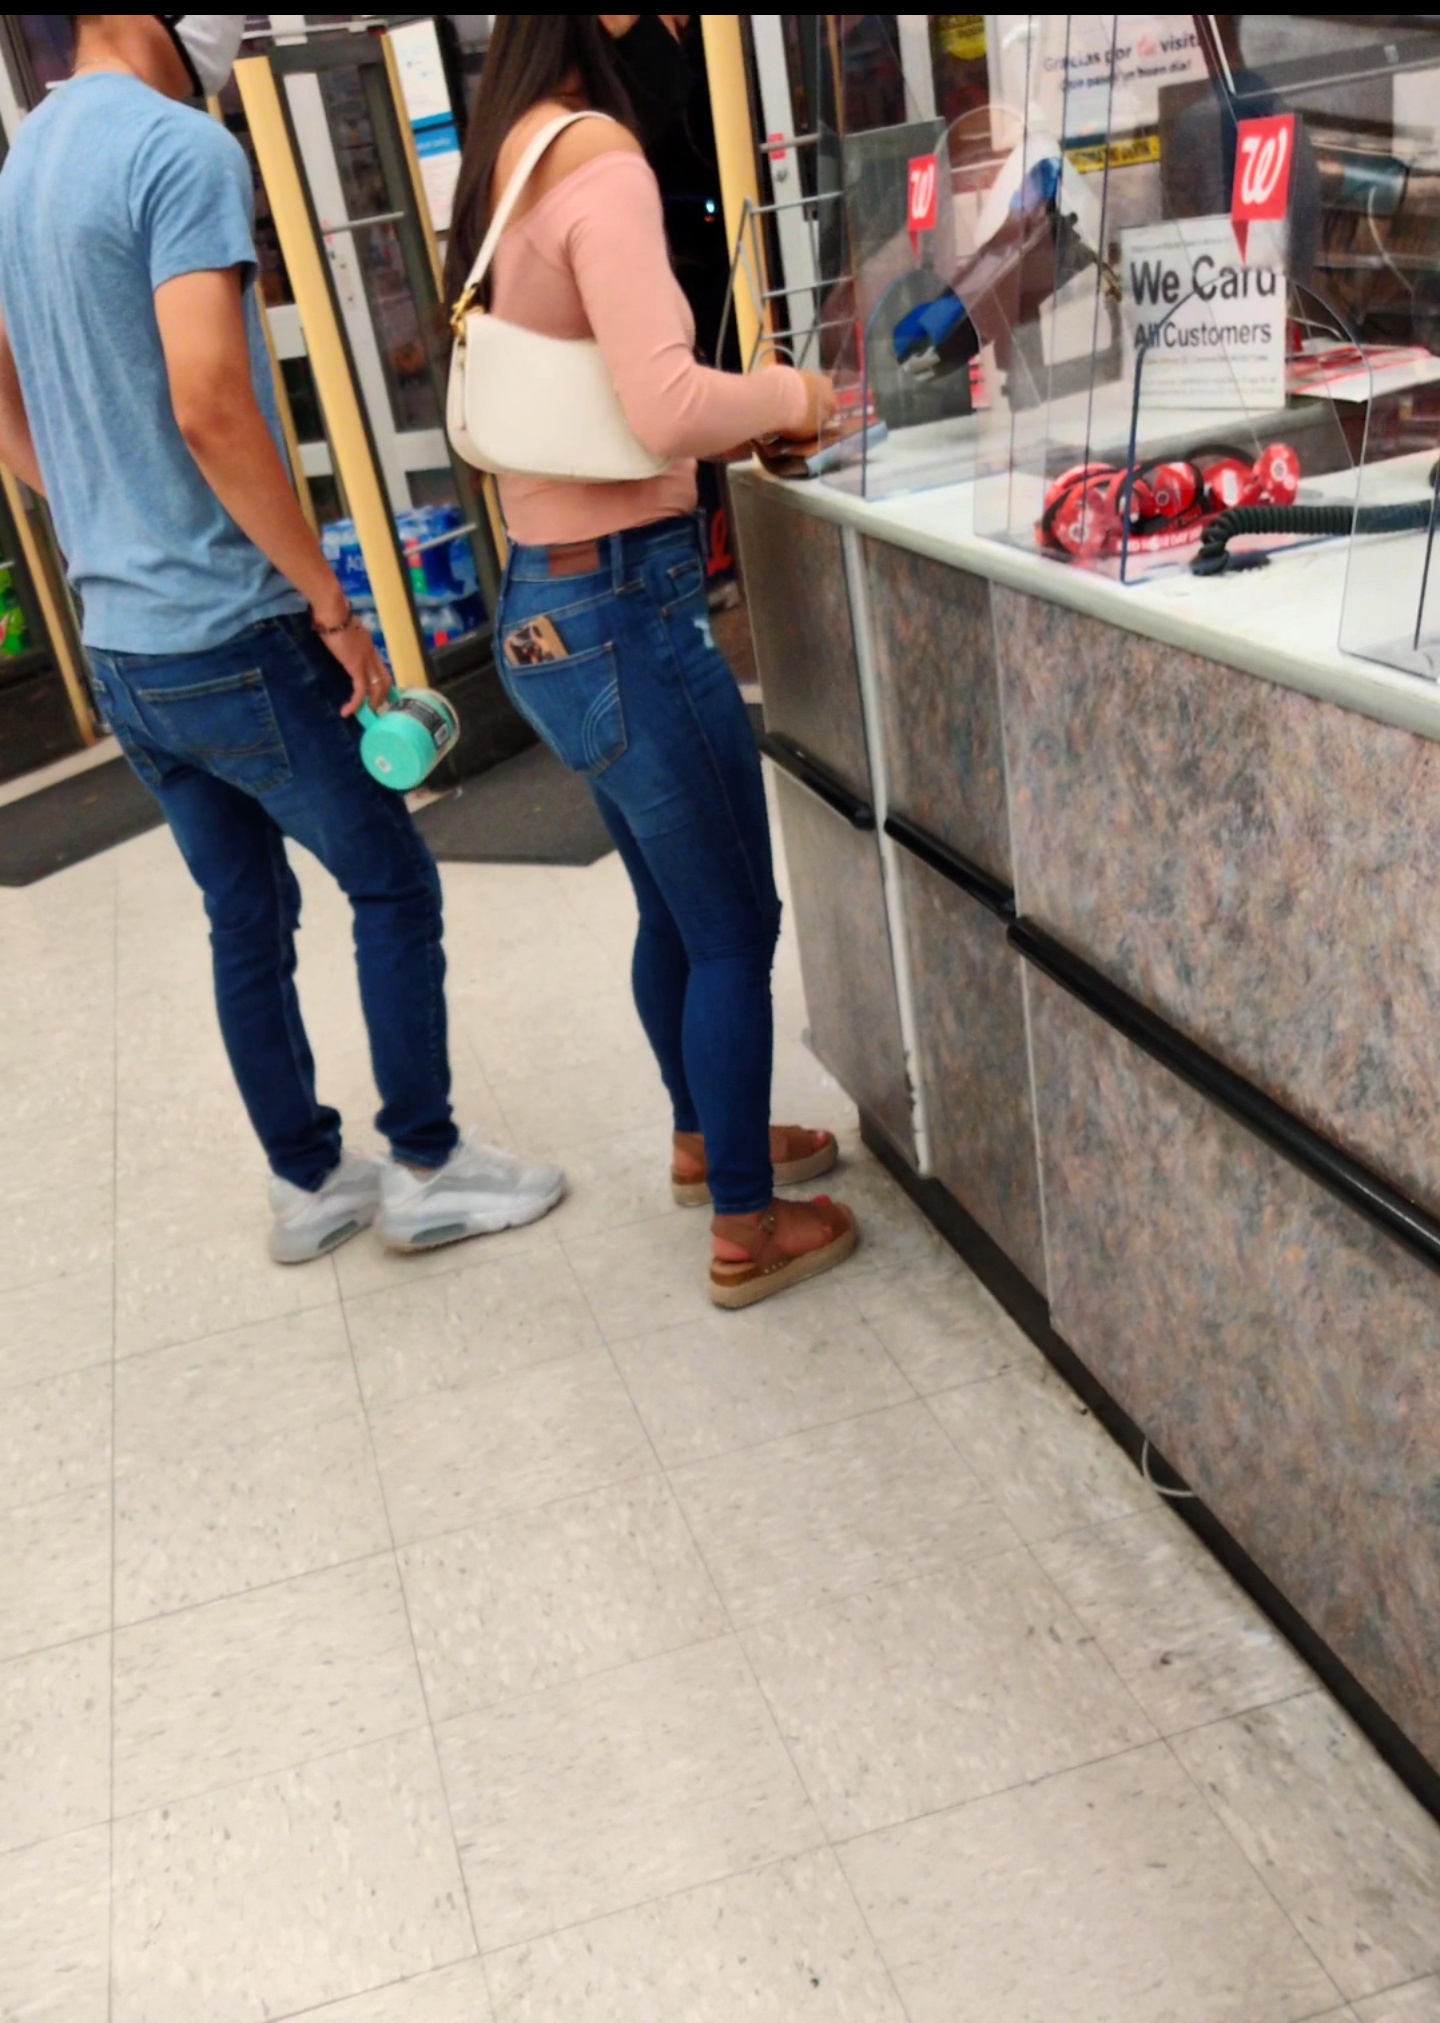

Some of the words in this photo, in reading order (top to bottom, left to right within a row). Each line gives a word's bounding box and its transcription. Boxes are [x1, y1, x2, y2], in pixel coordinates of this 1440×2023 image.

[1104, 46, 1132, 65] por
[1160, 33, 1201, 52] visit
[1241, 126, 1288, 206] W
[1130, 260, 1180, 306] We
[1134, 320, 1161, 350] All
[1163, 321, 1272, 348] Customers
